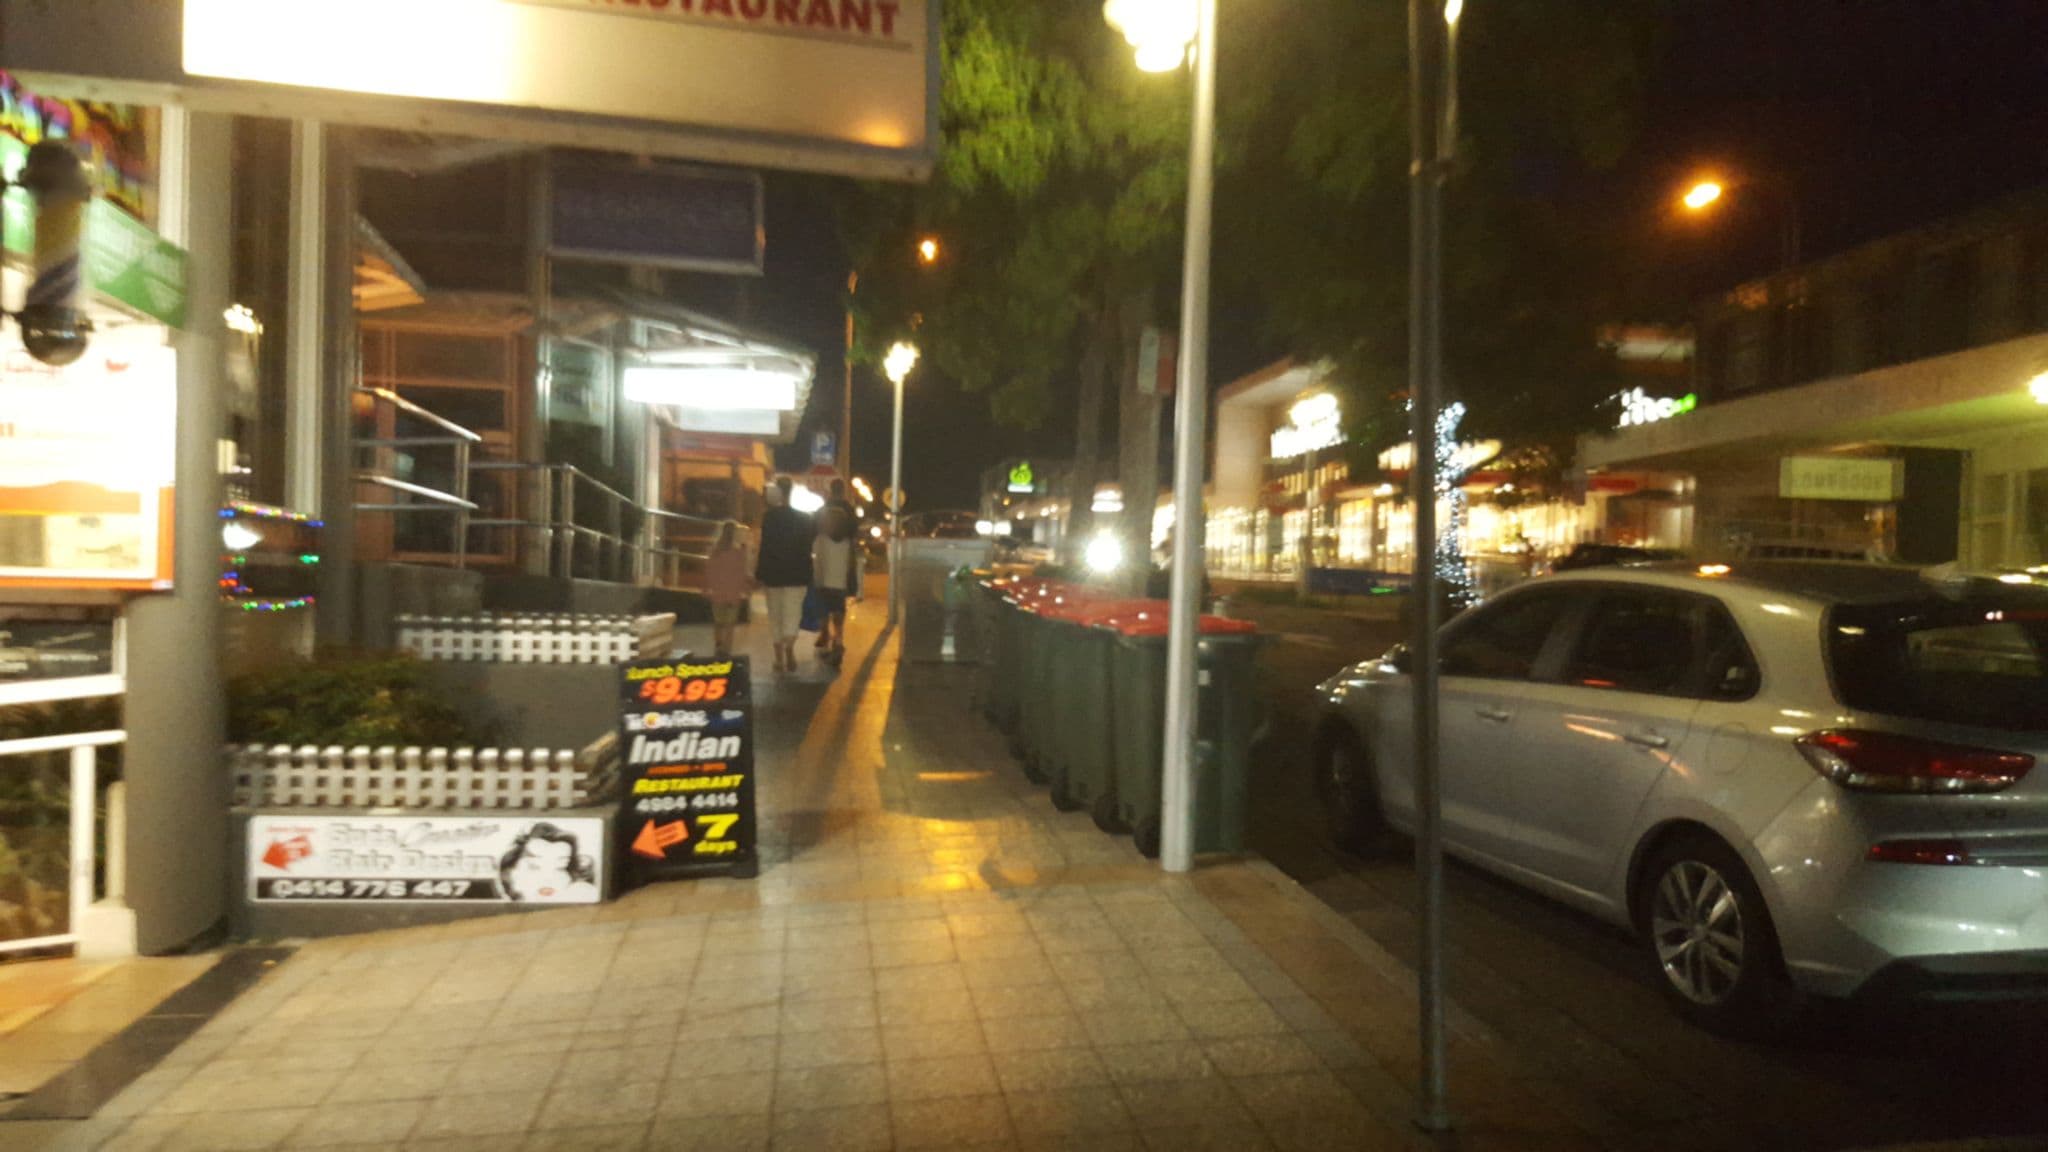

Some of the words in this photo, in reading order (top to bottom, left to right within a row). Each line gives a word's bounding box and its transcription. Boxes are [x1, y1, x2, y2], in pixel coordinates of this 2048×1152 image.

[589, 0, 899, 36] AURANT
[676, 661, 733, 678] Special
[640, 677, 728, 704] $9.95
[629, 731, 741, 764] Indian
[691, 792, 738, 808] 4414
[696, 813, 739, 839] 7
[694, 840, 738, 854] days
[272, 879, 346, 897] 0414
[413, 879, 472, 897] 447
